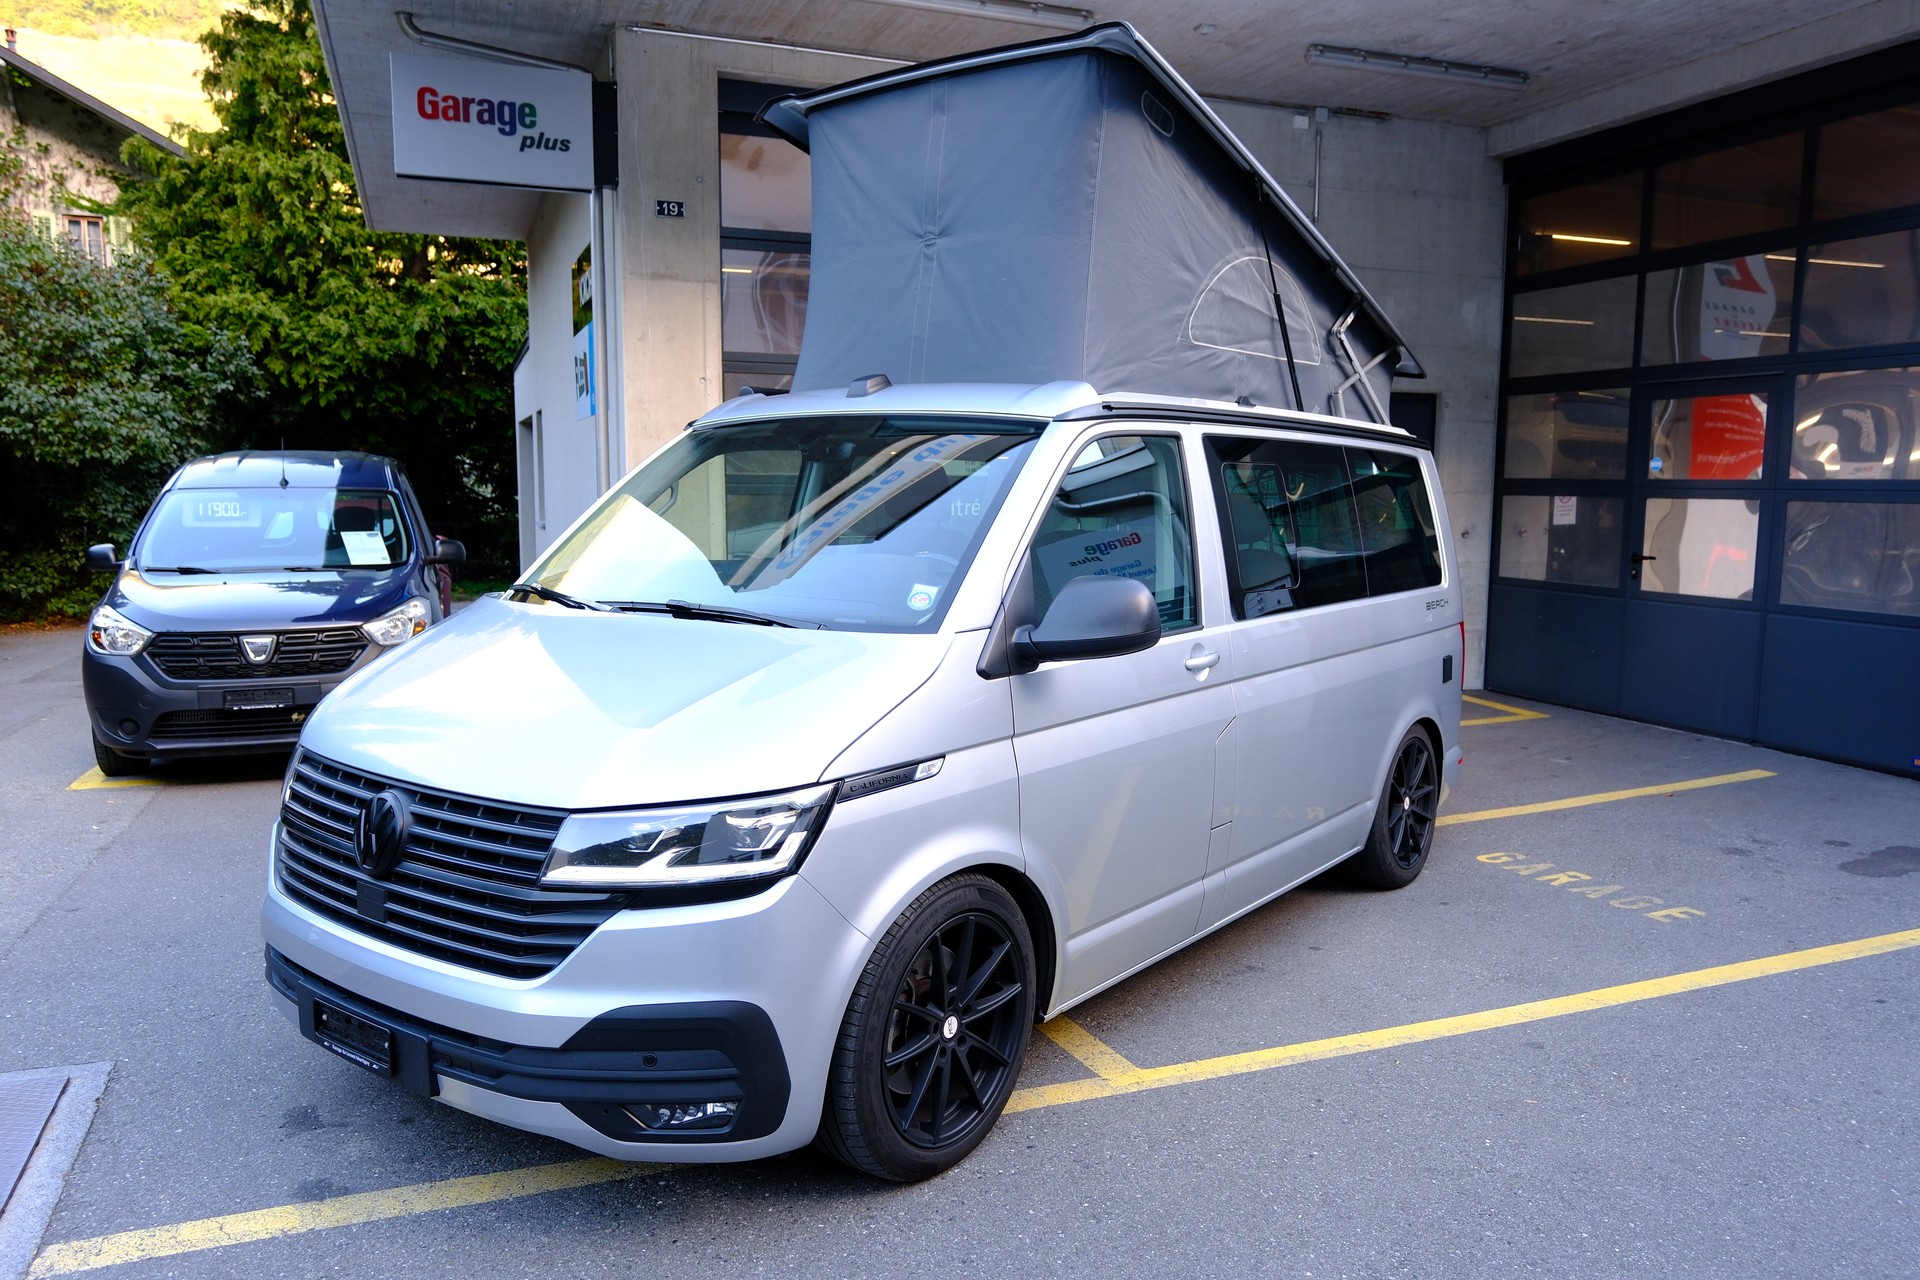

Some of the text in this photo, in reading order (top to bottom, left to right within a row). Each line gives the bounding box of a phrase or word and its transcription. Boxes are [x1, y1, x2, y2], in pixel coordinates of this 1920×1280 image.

[416, 86, 537, 136] Garage
[519, 132, 572, 152] plus
[661, 202, 679, 216] 19
[849, 773, 908, 793] CALIFORNIA
[1475, 852, 1706, 923] GARAGE
